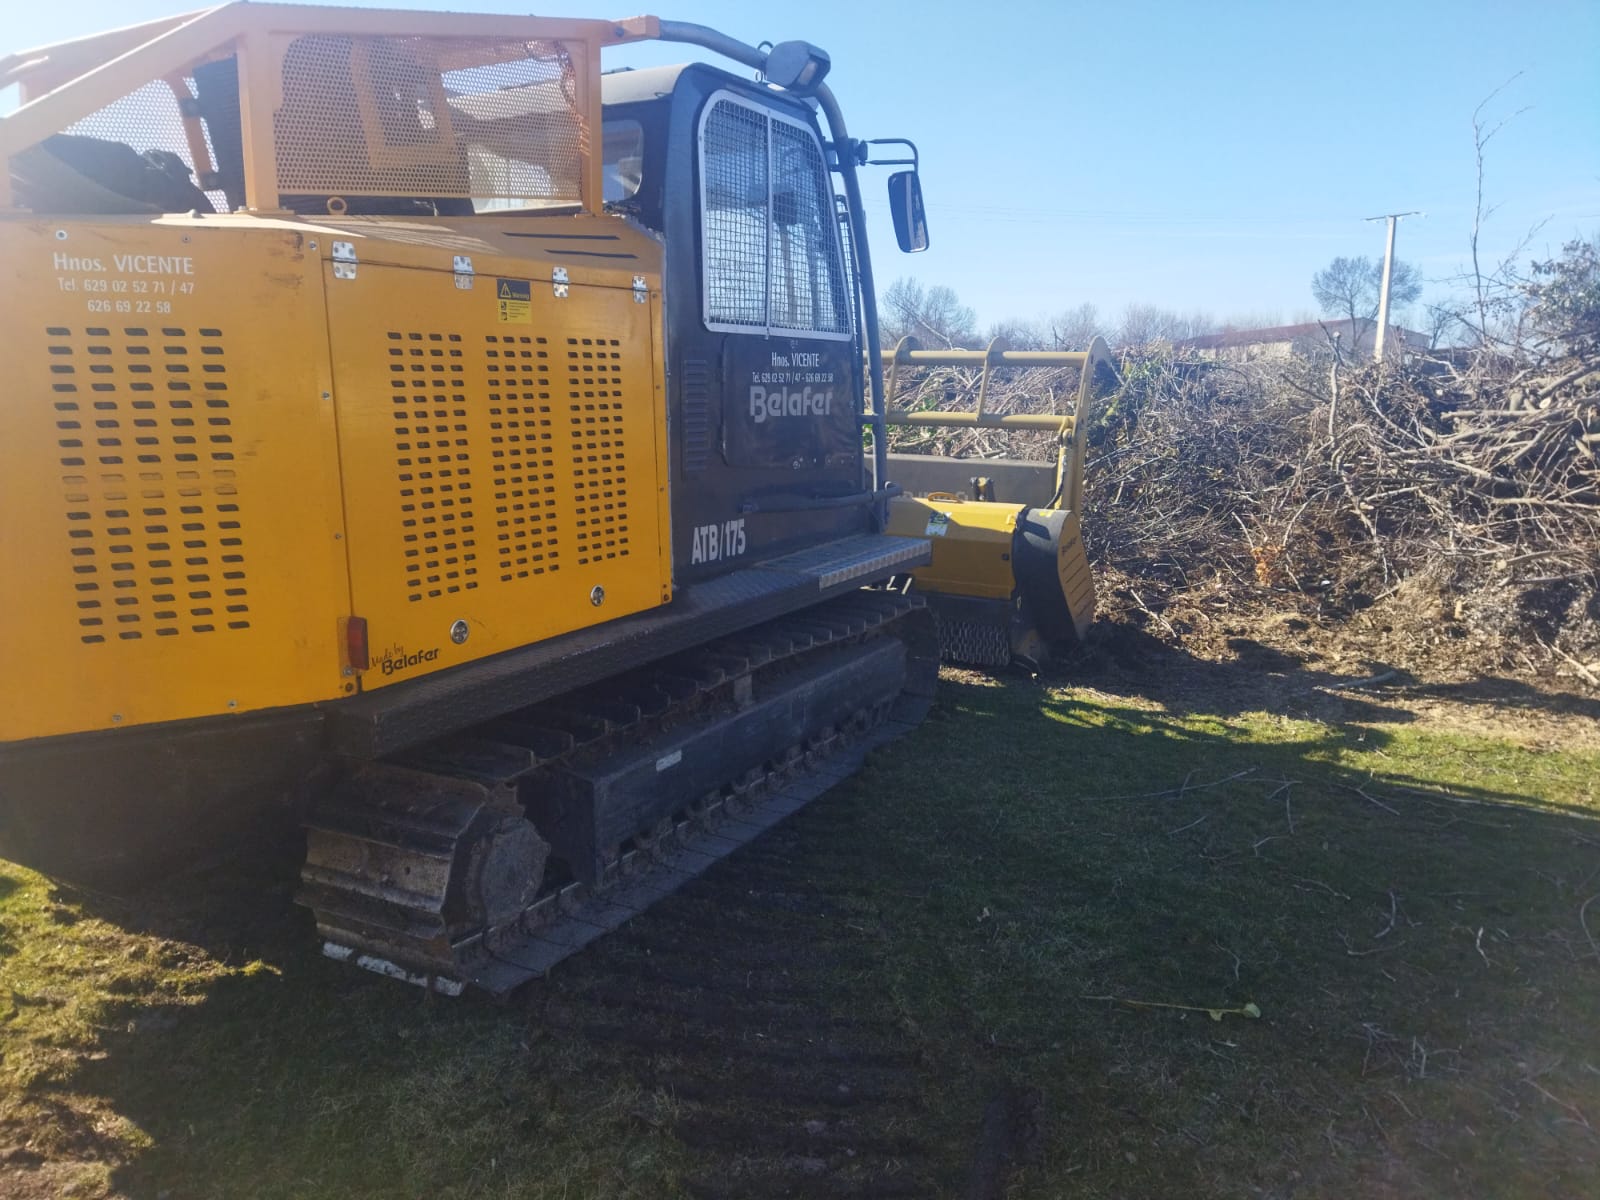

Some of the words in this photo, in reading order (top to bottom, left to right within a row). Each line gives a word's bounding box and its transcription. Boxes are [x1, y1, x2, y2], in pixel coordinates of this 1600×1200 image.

[53, 252, 107, 272] Hnos.
[113, 254, 195, 275] VICENTE
[57, 277, 79, 292] Tel.
[84, 279, 108, 293] 629
[112, 280, 128, 293] 02
[132, 280, 148, 294] 52
[153, 281, 166, 294] 71
[179, 282, 194, 295] 47
[87, 299, 111, 313] 626
[115, 300, 131, 313] 69
[136, 300, 151, 314] 22
[156, 301, 171, 314] 58
[771, 351, 790, 367] Hnos.
[791, 352, 820, 367] VICENTE
[749, 385, 834, 424] Belafer
[691, 518, 746, 565] ATB/175
[382, 648, 439, 676] Belafer
